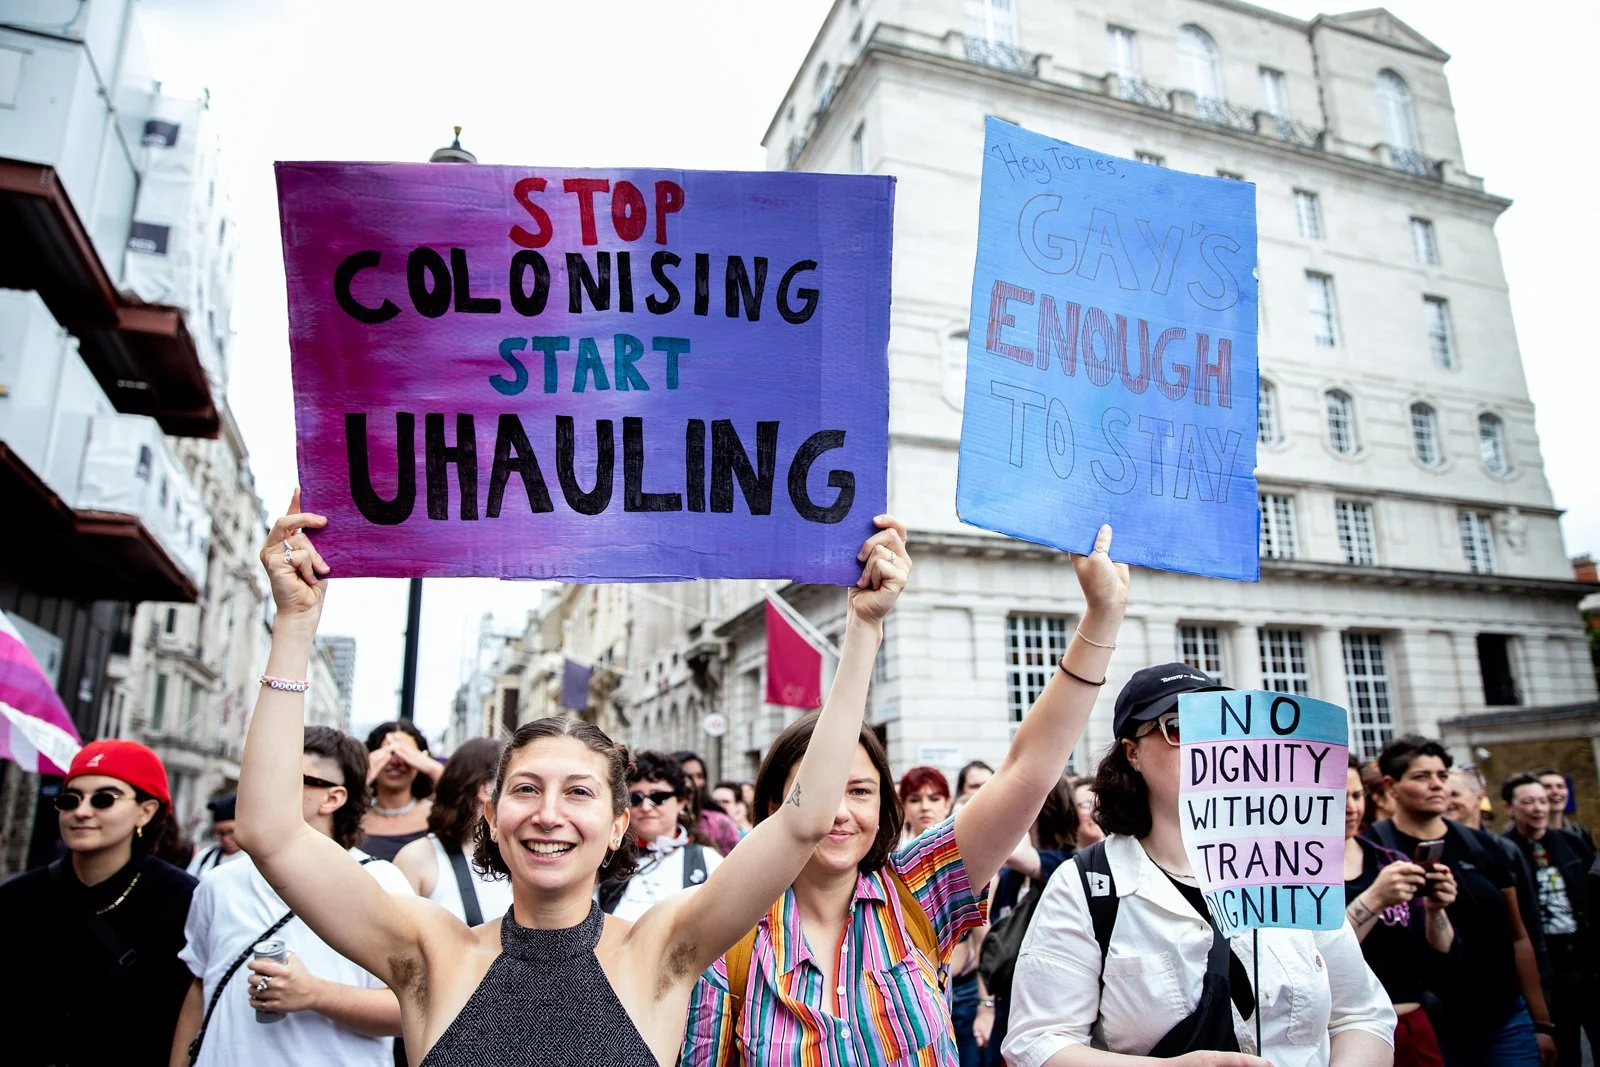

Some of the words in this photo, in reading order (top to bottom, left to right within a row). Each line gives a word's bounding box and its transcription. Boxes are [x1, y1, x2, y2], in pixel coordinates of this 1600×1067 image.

[1043, 146, 1126, 180] Tories,
[508, 176, 686, 249] STOP
[1017, 193, 1241, 312] GAY'S
[333, 245, 820, 325] COLONISING
[488, 332, 691, 396] START
[985, 279, 1232, 410] ENOUGH
[343, 411, 857, 526] UHAULING
[990, 379, 1076, 481] TO
[1090, 406, 1242, 504] STAY
[1220, 694, 1301, 736] NO
[1190, 743, 1331, 786] DIGNITY
[1187, 793, 1335, 831] WITHOUT
[1196, 840, 1325, 883] TRANS
[1204, 885, 1330, 934] DIGNITY
